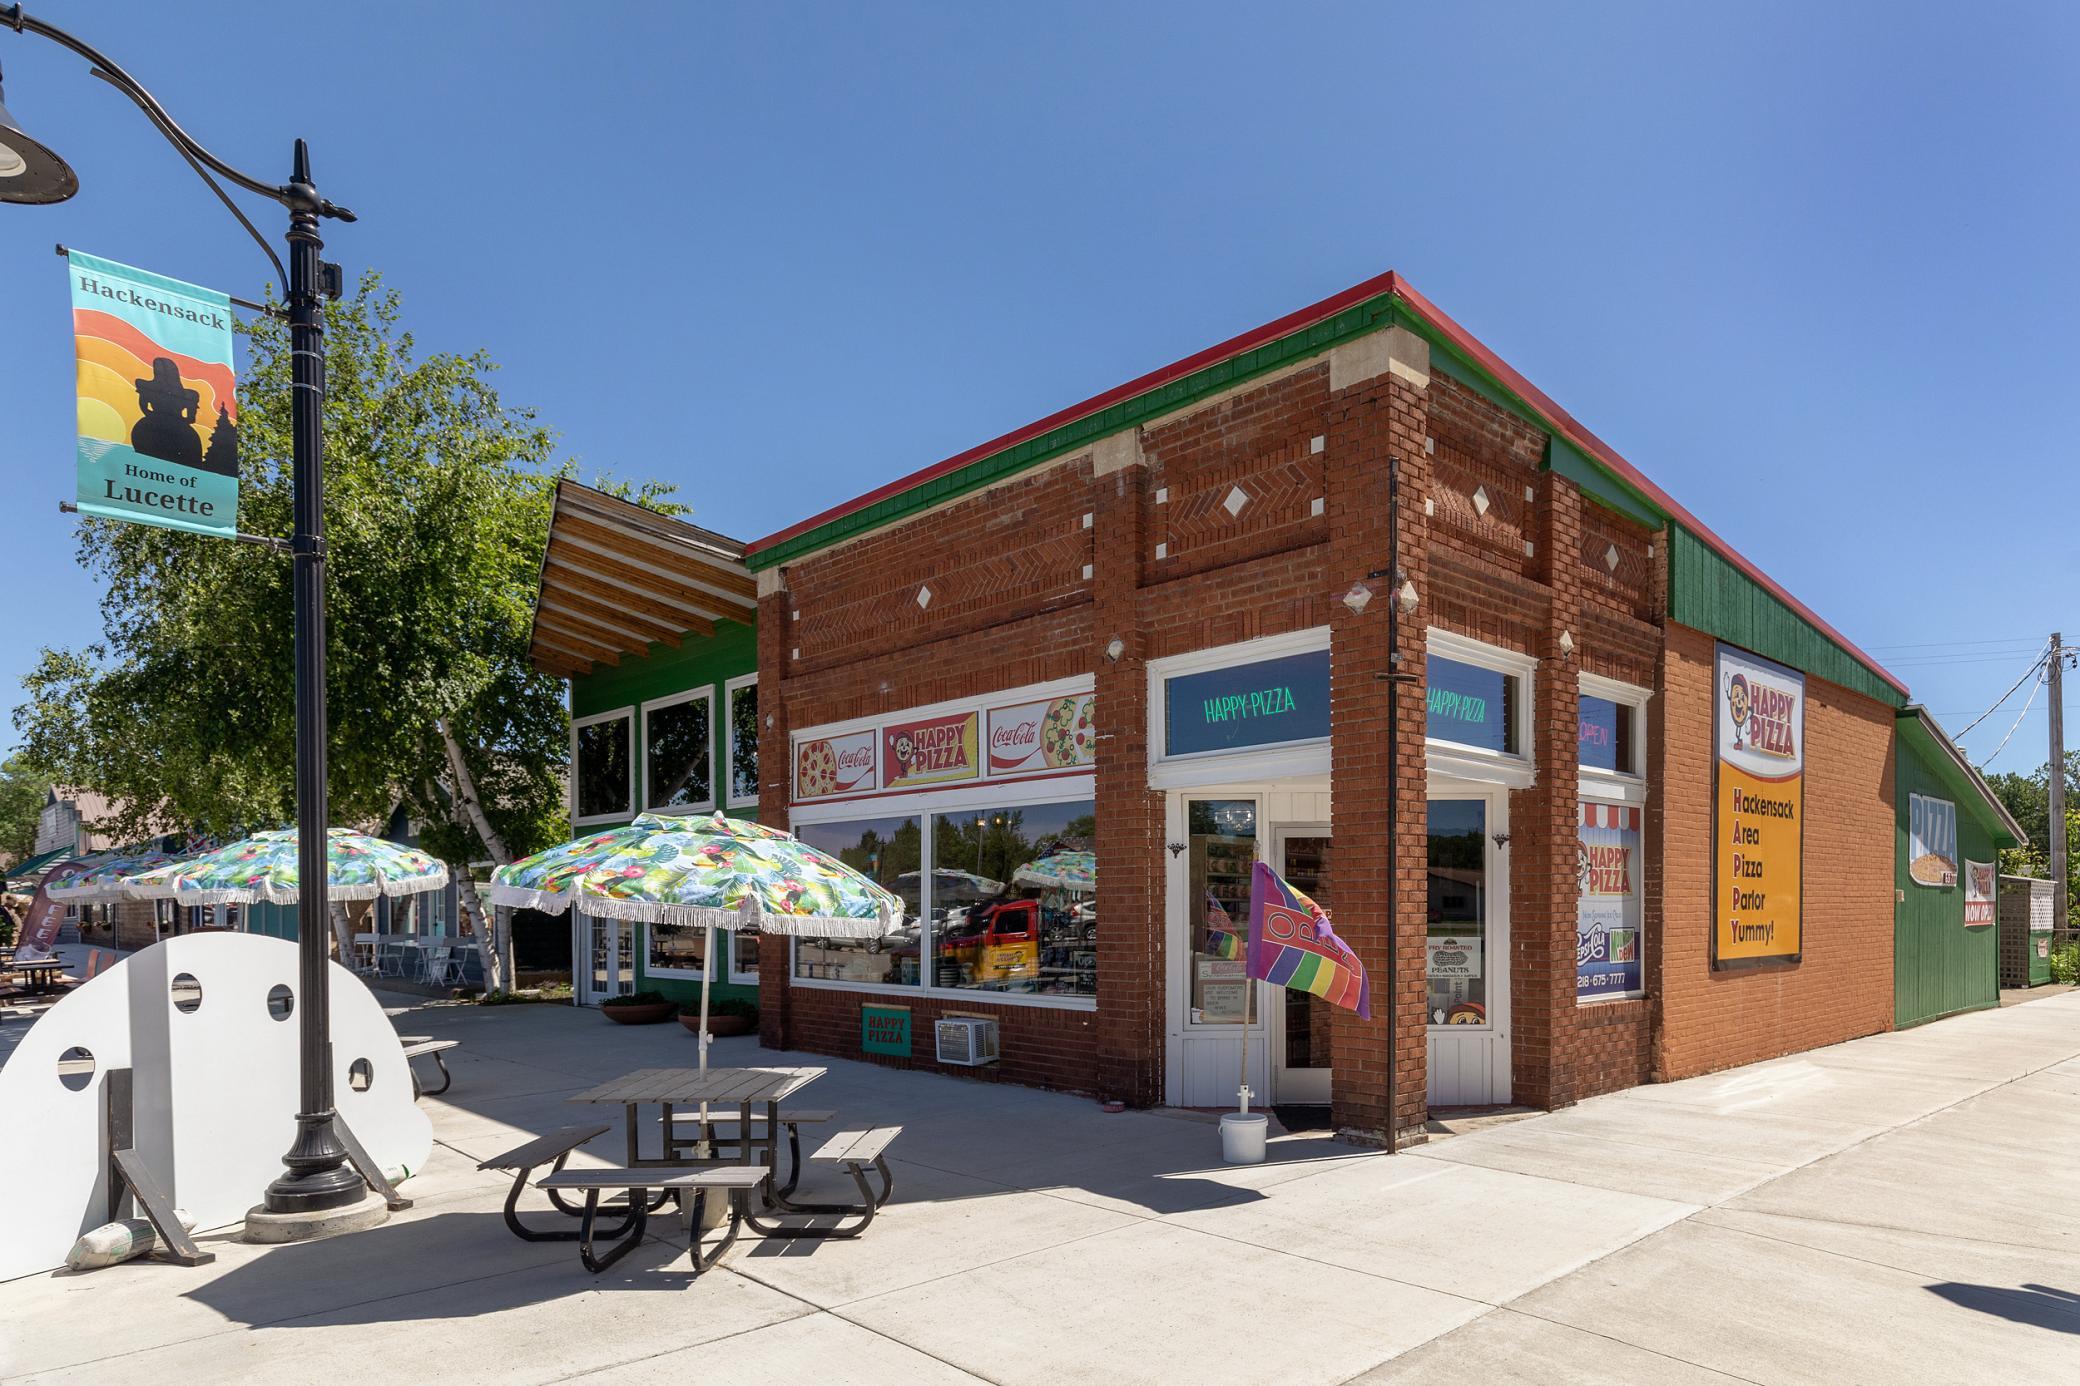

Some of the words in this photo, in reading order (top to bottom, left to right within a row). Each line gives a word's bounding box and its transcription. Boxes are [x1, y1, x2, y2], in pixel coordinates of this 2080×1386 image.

[79, 276, 225, 331] Hackensack
[125, 464, 175, 484] Home
[180, 477, 198, 488] of
[104, 479, 214, 517] Lucette
[1204, 694, 1247, 724] HAPPY
[1250, 686, 1296, 717] PIZZA
[1426, 686, 1462, 719] HAPPY
[1460, 695, 1486, 722] PIZZA
[1750, 682, 1795, 724] HAPPY
[914, 722, 967, 750] HAPPY
[992, 720, 1038, 749] Coca-Cola
[1579, 721, 1608, 746] OPEN
[1750, 714, 1795, 760] PIZZA
[838, 745, 872, 770] Coca-Cola
[915, 744, 969, 773] PIZZA
[1732, 787, 1794, 820] Hackensack
[1732, 819, 1760, 845] Area
[1911, 797, 1957, 866] PIZZA
[1588, 845, 1632, 870] HAPPY
[1732, 853, 1763, 879] Pizza
[1588, 868, 1632, 896] PIZZA
[1731, 885, 1766, 912] Parlor
[1965, 904, 1980, 922] NOW
[1730, 918, 1774, 946] Yummy!
[869, 1016, 904, 1029] HAPPY
[868, 1031, 903, 1043] PIZZA
